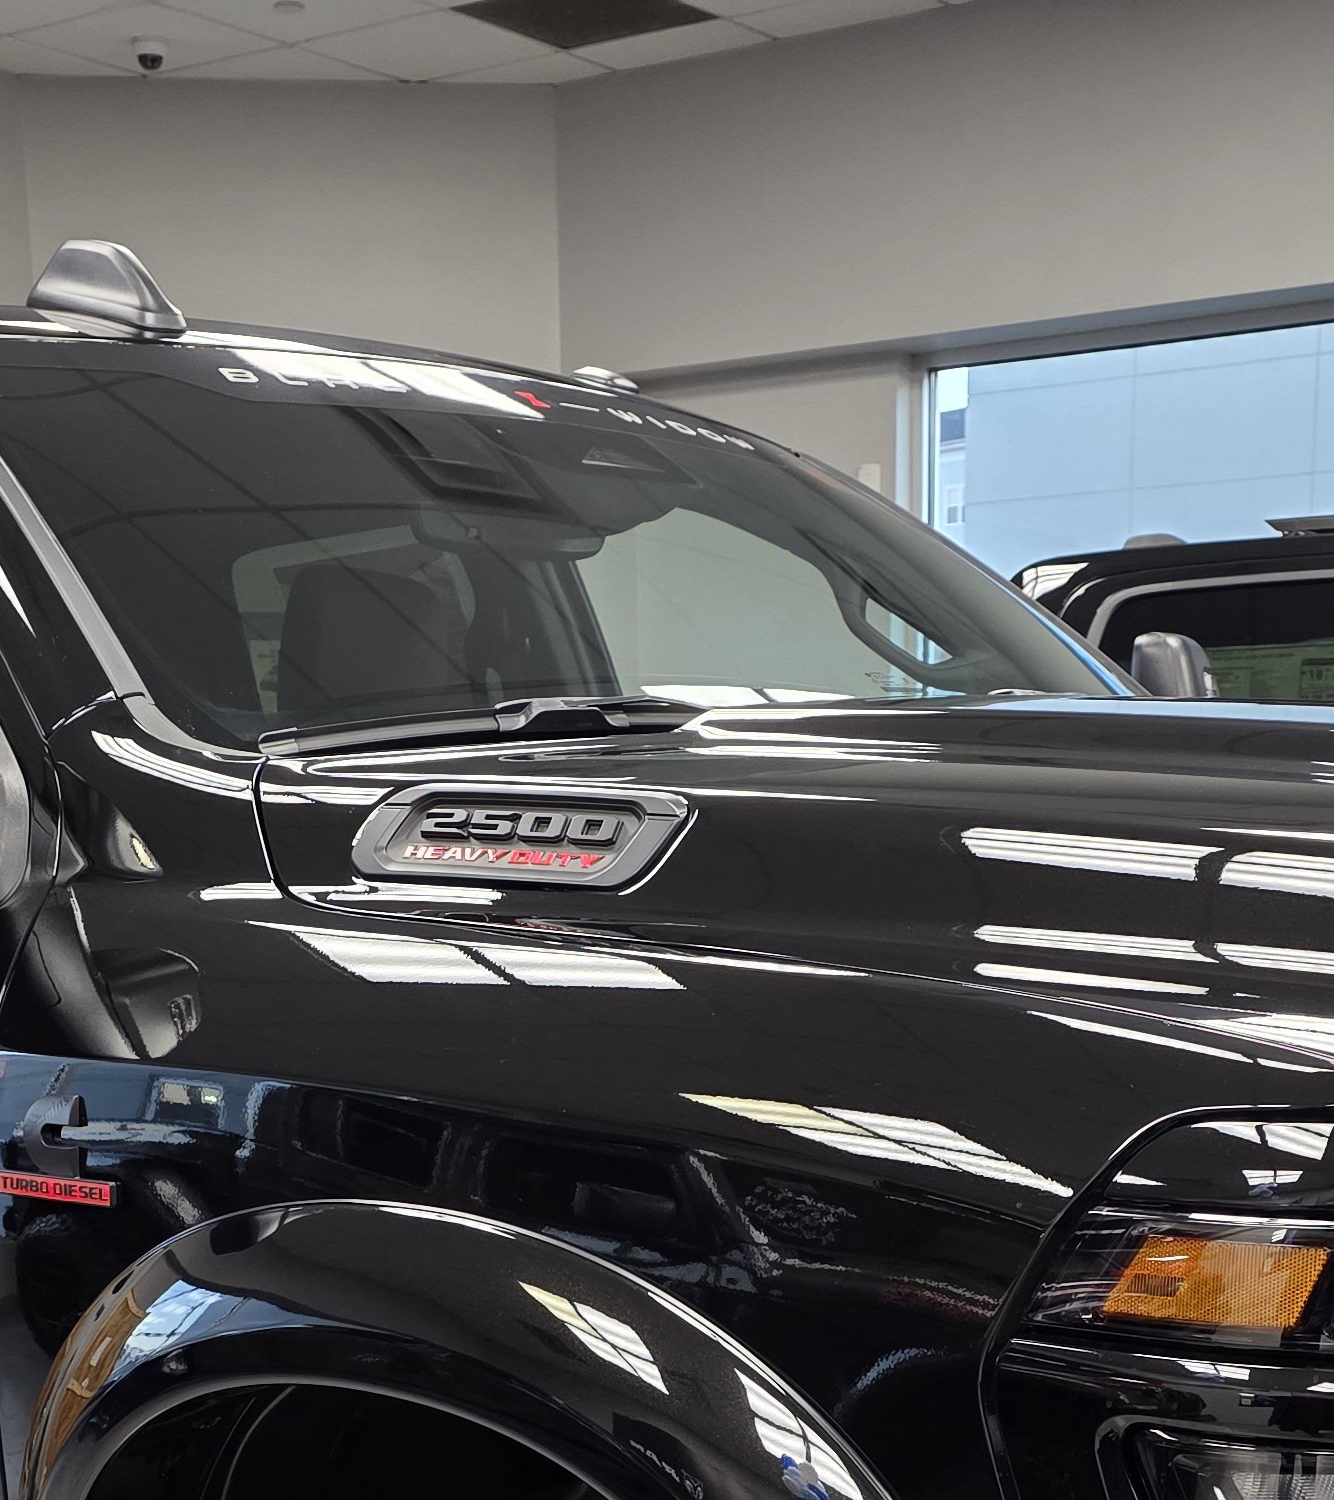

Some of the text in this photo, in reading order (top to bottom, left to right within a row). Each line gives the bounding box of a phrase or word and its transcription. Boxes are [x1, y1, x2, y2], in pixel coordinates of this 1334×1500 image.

[606, 407, 755, 450] WIDOW
[420, 808, 622, 848] 2500
[402, 844, 605, 868] HEAVY DUTY
[0, 1175, 109, 1202] TURBO DIESEL
